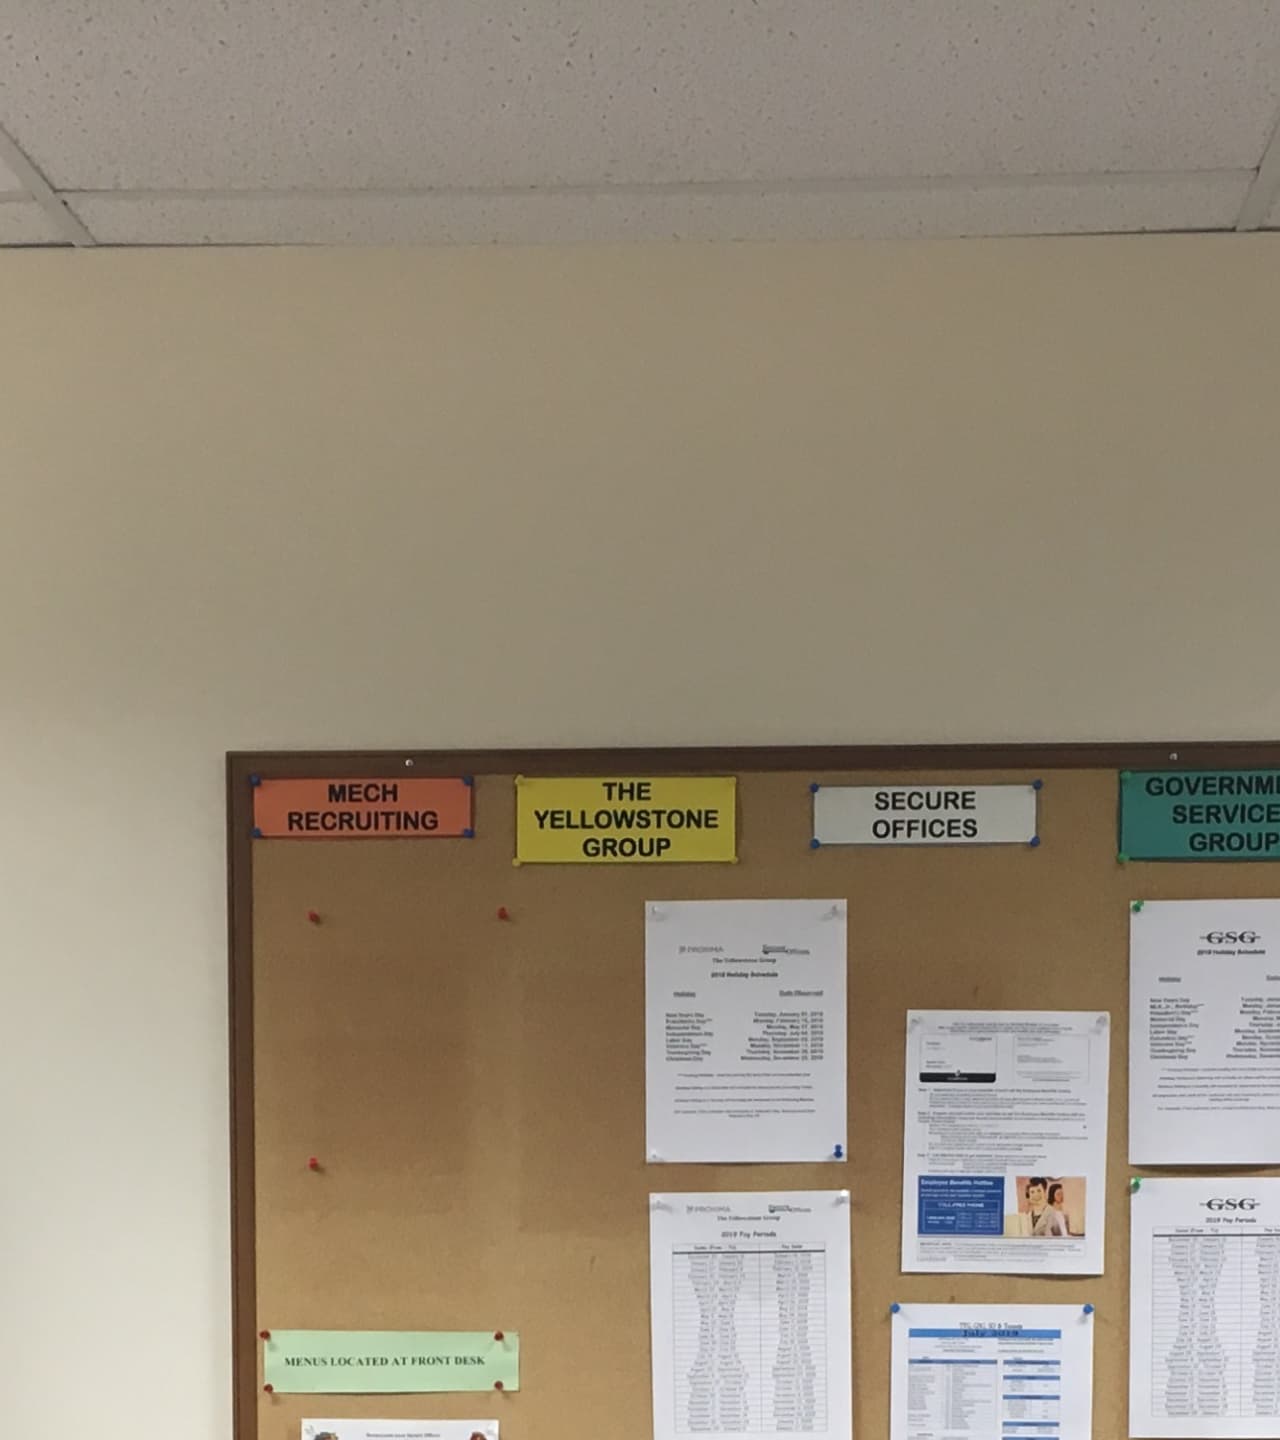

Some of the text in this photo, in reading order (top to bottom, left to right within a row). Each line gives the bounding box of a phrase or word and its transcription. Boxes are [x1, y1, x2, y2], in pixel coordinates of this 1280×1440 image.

[327, 783, 399, 803] MECH
[602, 782, 652, 801] THE
[874, 791, 977, 811] SECURE
[287, 810, 439, 832] RECRUITING
[533, 809, 719, 829] YELLOWSTONE
[871, 818, 979, 839] OFFICES
[582, 837, 672, 858] GROUP
[1188, 831, 1280, 852] GROUP
[1205, 930, 1257, 945] GSG
[1205, 1197, 1257, 1211] GSG
[284, 1354, 486, 1368] MENUS LOCATED AT FRONT DESK
